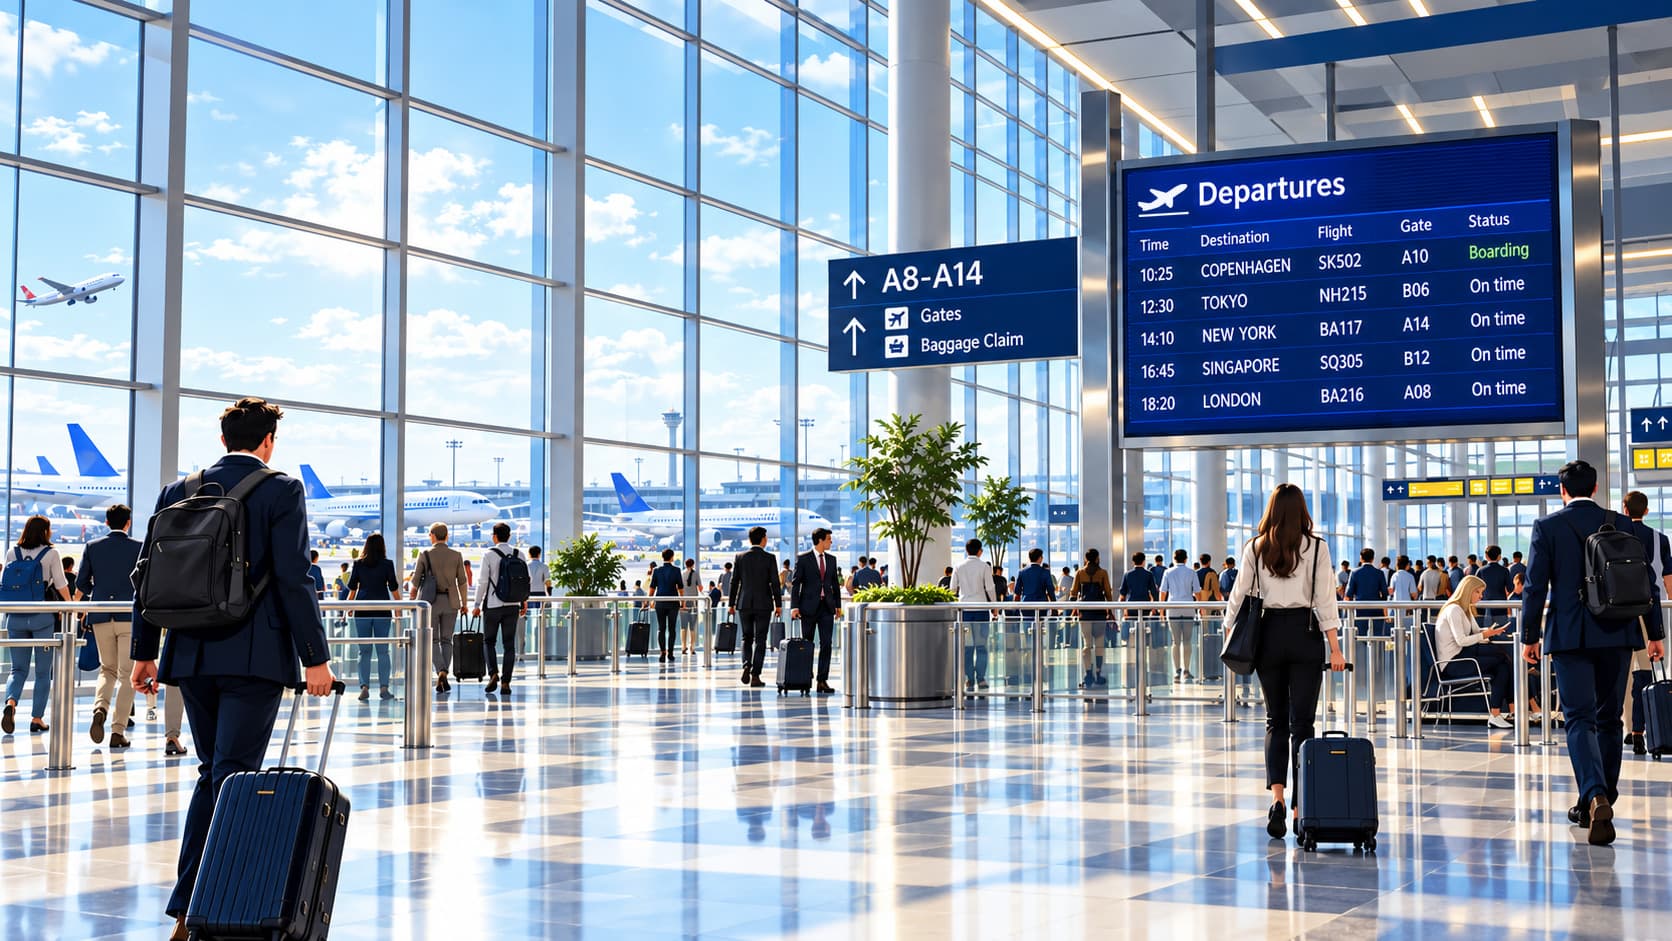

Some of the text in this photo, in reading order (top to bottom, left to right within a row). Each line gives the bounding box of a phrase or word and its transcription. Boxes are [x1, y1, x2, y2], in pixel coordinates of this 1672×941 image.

[1199, 177, 1345, 209] Departures
[1140, 214, 1509, 251] Time Destination Flight Gate Status
[882, 260, 983, 293] A8-A14
[1141, 243, 1529, 281] 10:25 COPENHAGEN SK502 A10 Boarding
[1141, 277, 1524, 313] 12:30 TOKYO NH215 B06 On time
[921, 308, 961, 323] Gates
[1141, 311, 1525, 346] 14:10 NEW YORK BA117 A14 On time
[922, 332, 1023, 355] Baggage Claim
[1140, 346, 1525, 378] 16:45 SINGAPORE SQ305 B12 On time
[1141, 381, 1526, 411] 18:20 LONDON BA216 A08 On time
